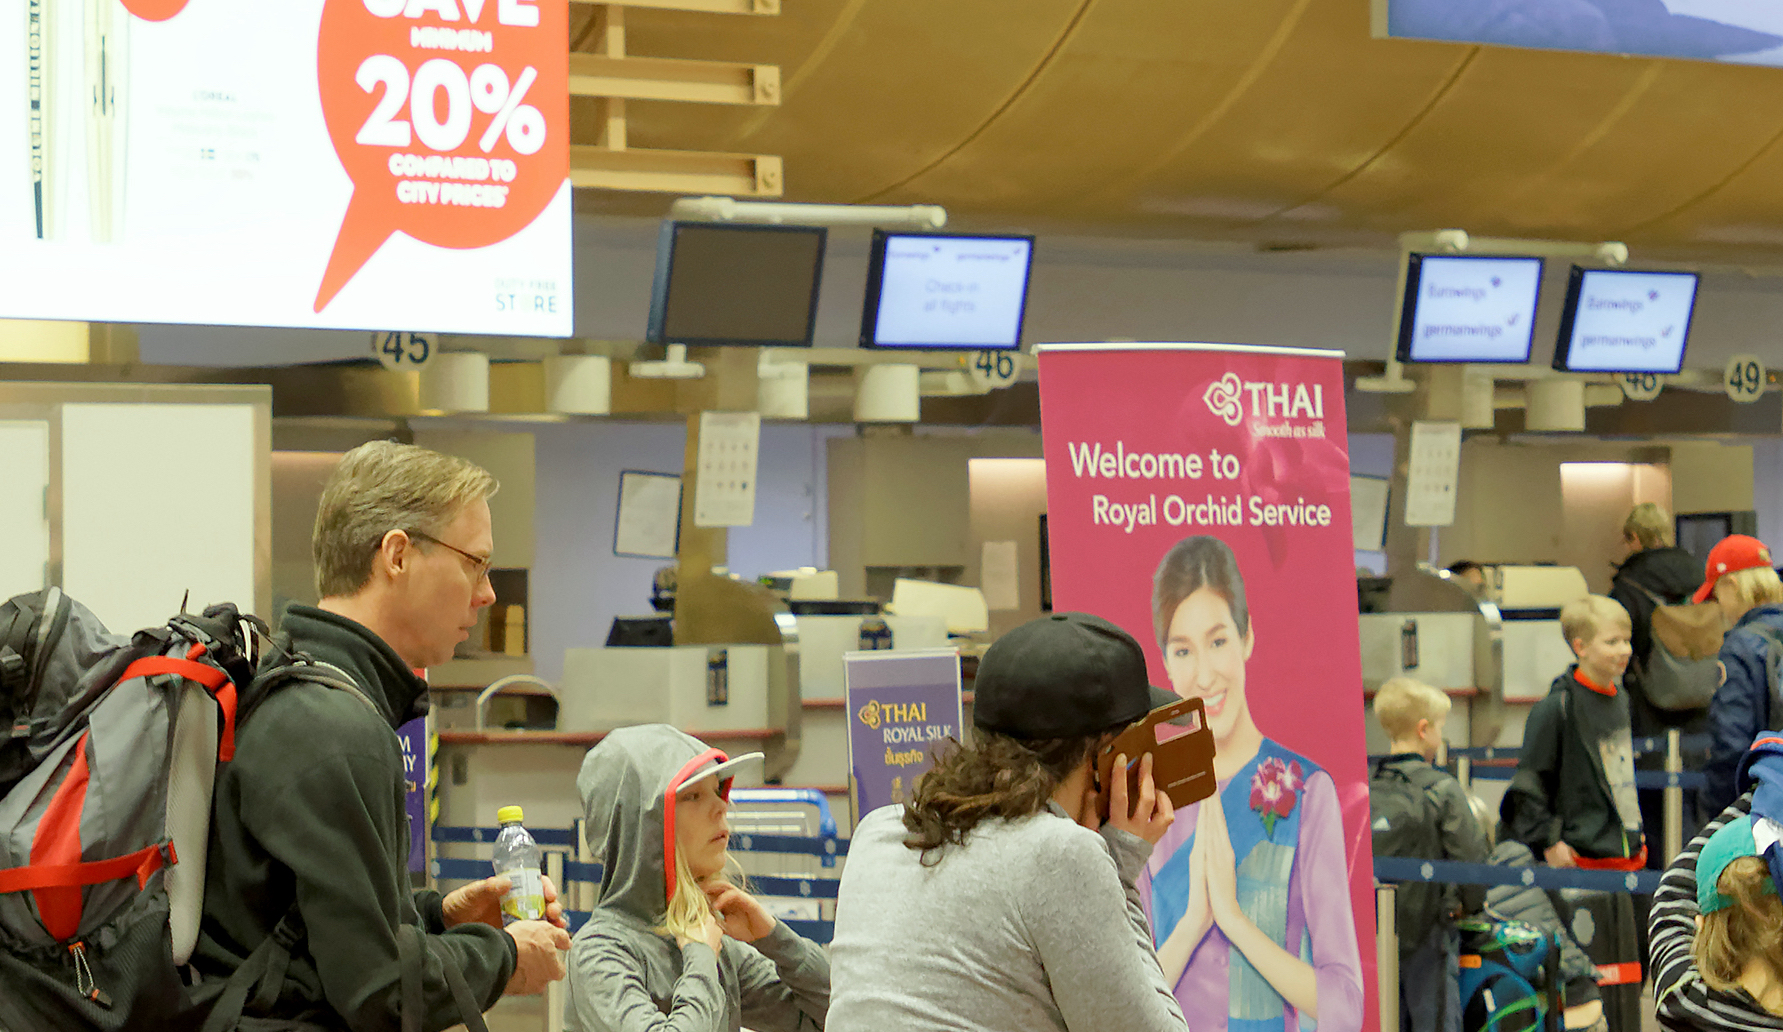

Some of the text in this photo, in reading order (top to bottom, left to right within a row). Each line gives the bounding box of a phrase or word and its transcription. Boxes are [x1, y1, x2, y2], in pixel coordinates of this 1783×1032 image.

[355, 54, 547, 155] 20%
[489, 158, 517, 182] TO
[396, 180, 440, 204] CITY
[495, 293, 557, 313] STRE
[382, 333, 430, 365] 45
[976, 350, 1014, 379] 46
[1729, 361, 1760, 395] 49
[1243, 381, 1325, 419] THAI
[1068, 440, 1241, 480] Welcome to
[1092, 494, 1332, 534] Royal Orchid Service
[881, 702, 927, 723] THAI
[883, 724, 952, 743] ROYAL SILK
